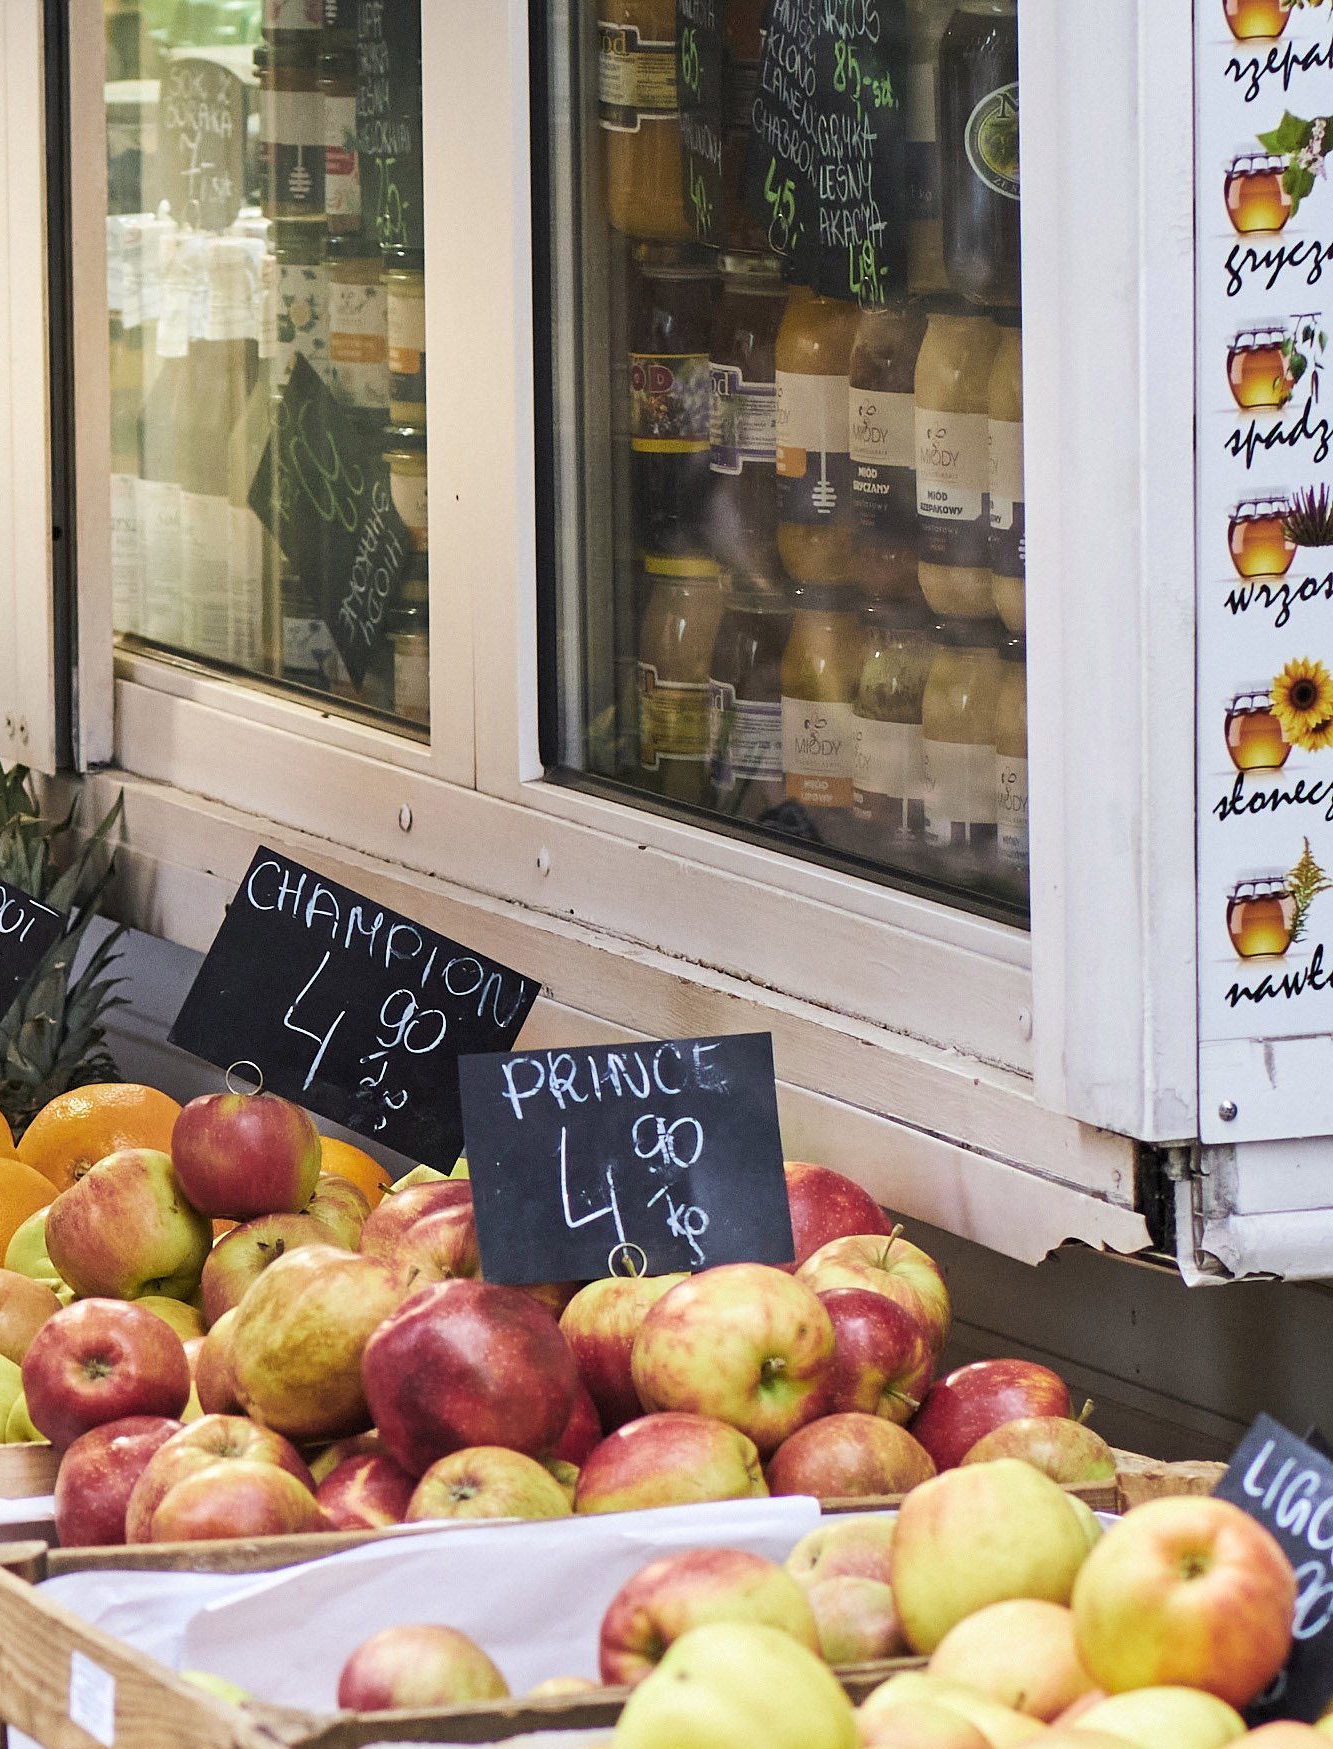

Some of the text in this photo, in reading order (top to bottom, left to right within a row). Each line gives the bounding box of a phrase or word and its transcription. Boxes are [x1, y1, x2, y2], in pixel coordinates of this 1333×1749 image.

[1224, 240, 1333, 297] grycz
[246, 860, 526, 1029] CHAMPION
[1224, 943, 1333, 1009] nawł
[283, 950, 447, 1092] 4 90
[501, 1042, 731, 1120] PRINCE
[561, 1113, 705, 1258] 4 90
